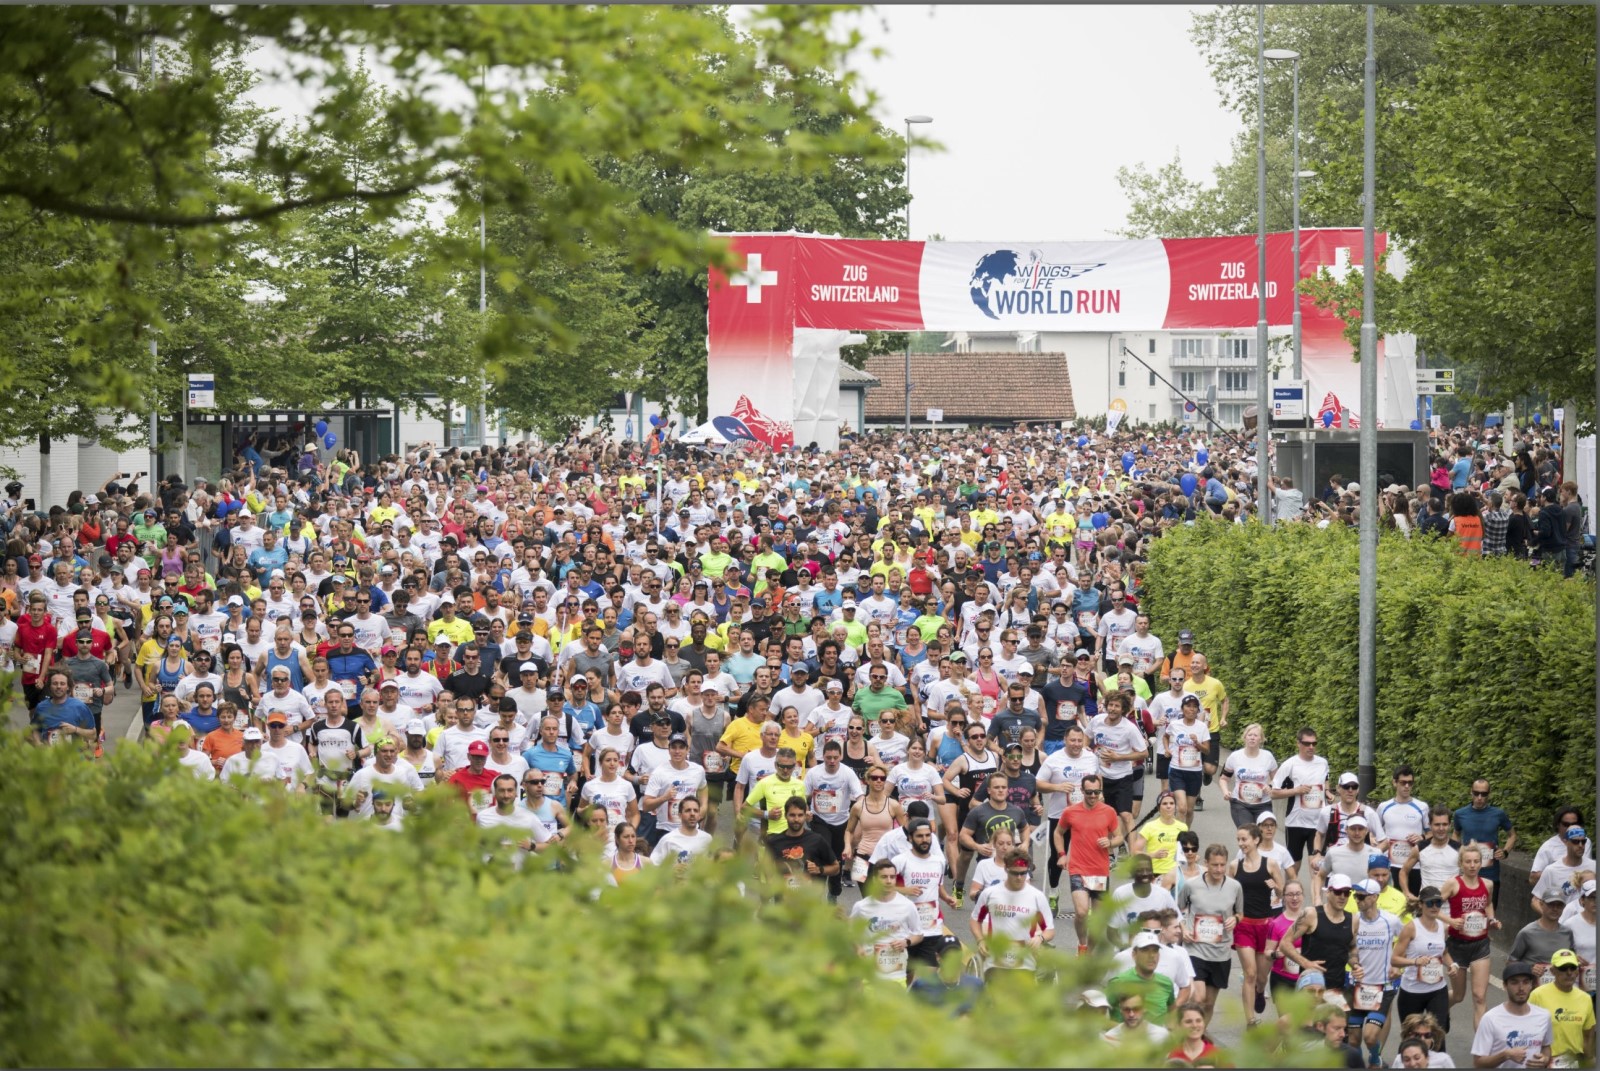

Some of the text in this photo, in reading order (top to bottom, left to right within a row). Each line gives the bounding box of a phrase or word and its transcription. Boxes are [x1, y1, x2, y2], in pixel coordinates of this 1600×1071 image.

[843, 265, 867, 281] ZUG
[1017, 264, 1071, 277] WINGS
[1220, 262, 1245, 279] ZUG
[1024, 278, 1055, 289] LIFE
[1188, 281, 1277, 301] SWITZERLAD
[811, 284, 899, 302] SWITZERLAND
[995, 289, 1120, 314] WORLD RUN
[1357, 937, 1386, 946] Charity
